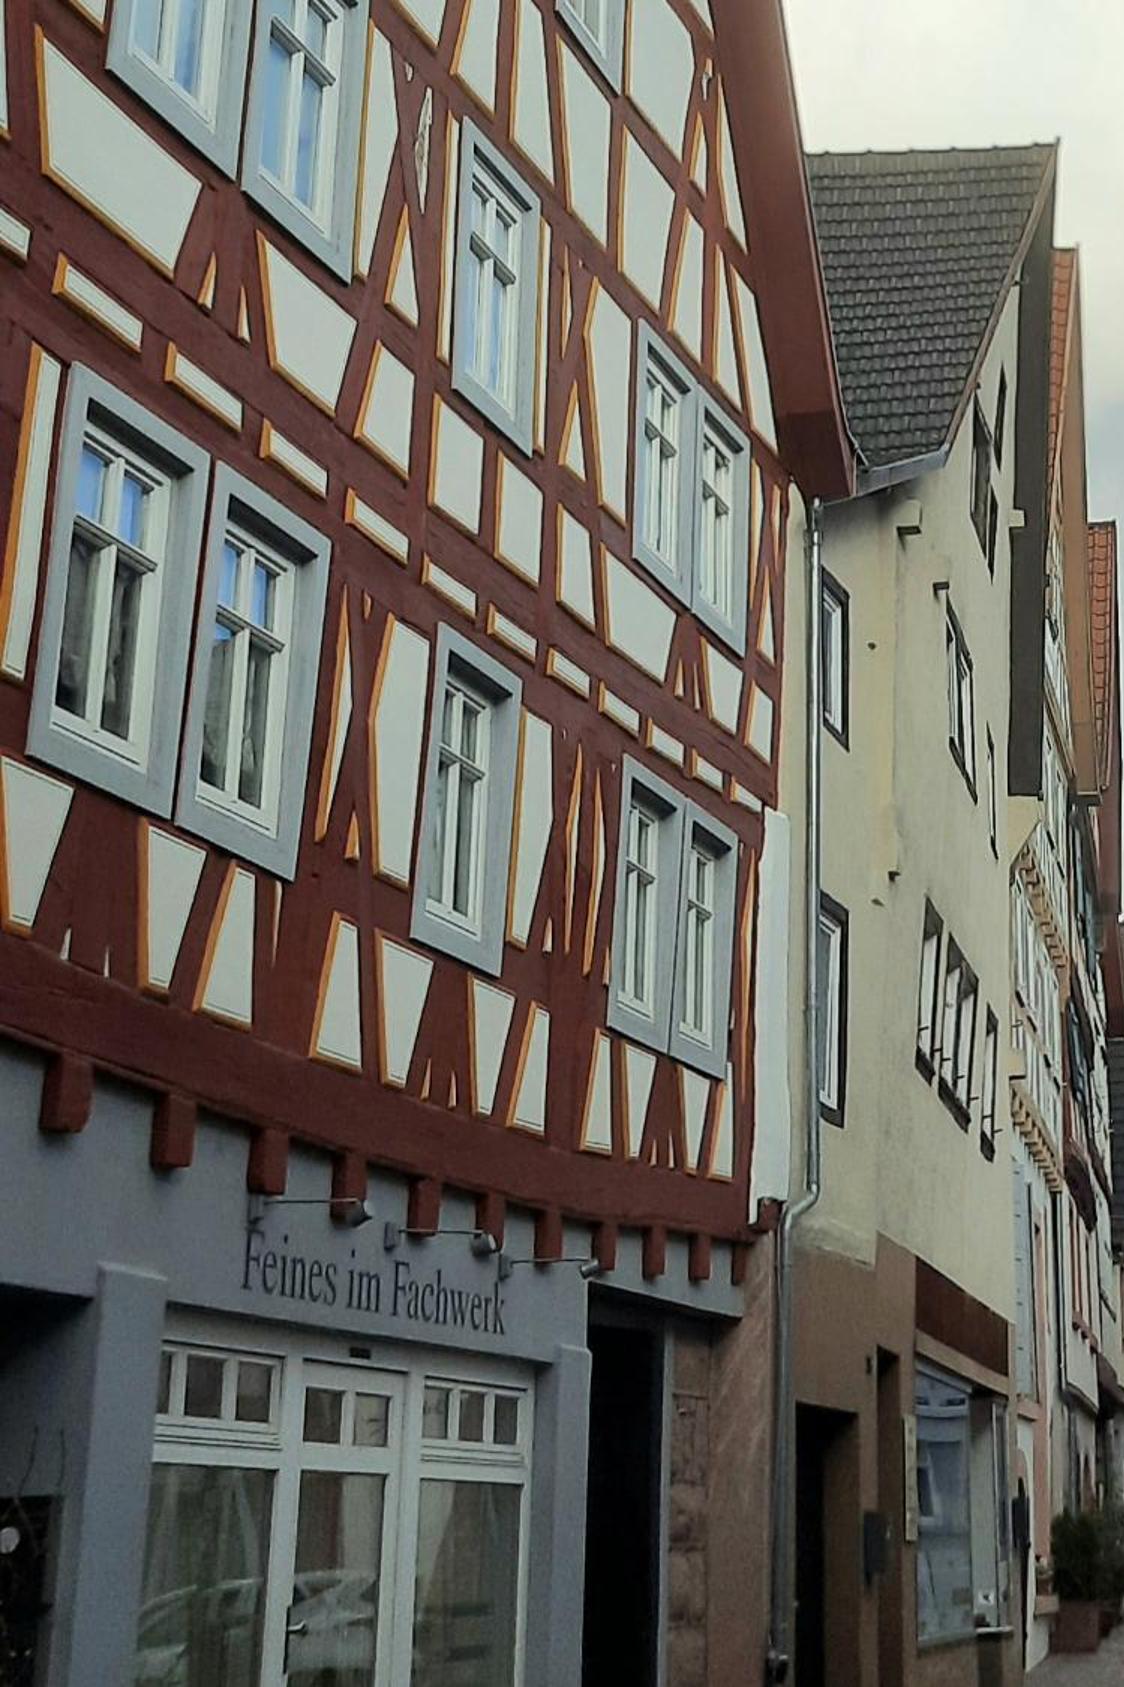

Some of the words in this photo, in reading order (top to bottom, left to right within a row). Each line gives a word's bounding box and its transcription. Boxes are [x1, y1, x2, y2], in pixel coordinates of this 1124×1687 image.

[241, 1228, 337, 1306] Feines
[346, 1249, 381, 1313] im
[390, 1260, 505, 1334] Fachwerk
